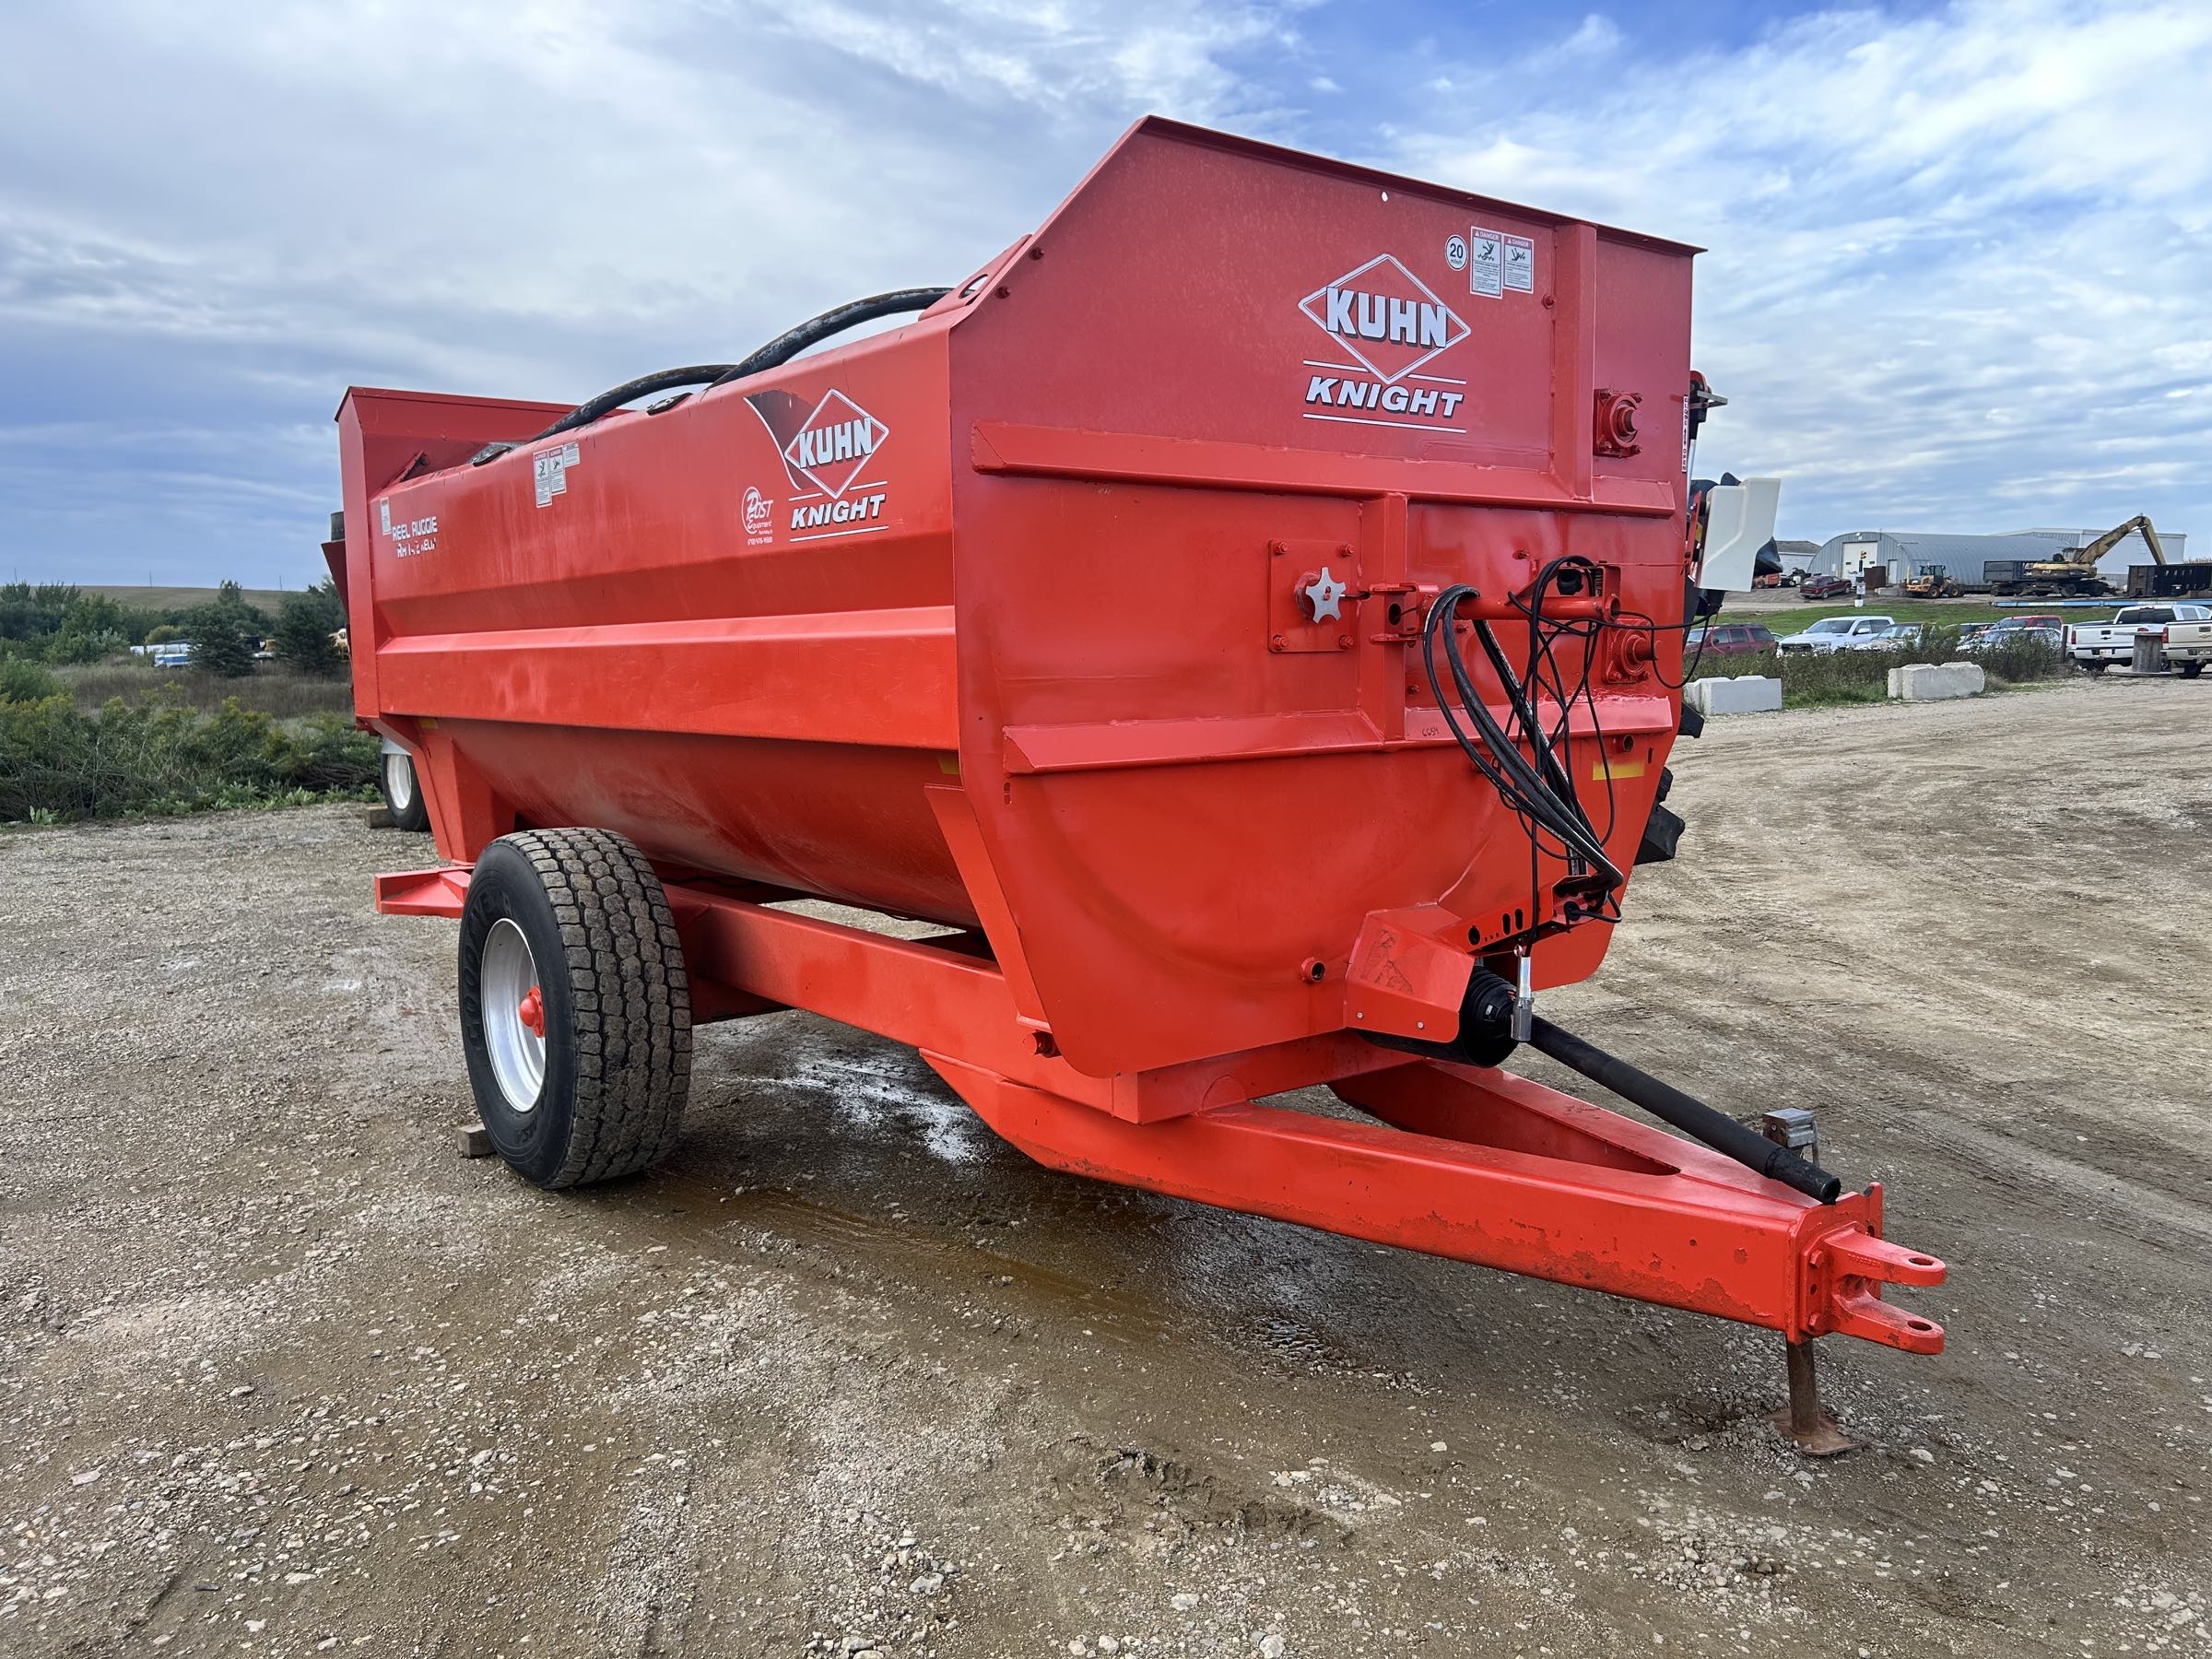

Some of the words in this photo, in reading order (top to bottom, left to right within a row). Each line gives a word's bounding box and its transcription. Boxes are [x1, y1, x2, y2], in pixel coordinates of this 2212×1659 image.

[1450, 243, 1464, 259] 20
[1479, 230, 1500, 241] DANGER
[1512, 237, 1529, 247] DANGER
[1325, 287, 1446, 349] KUHN
[1305, 375, 1465, 418] KNIGHT
[798, 417, 873, 469] KUHN
[790, 493, 887, 530] KNIGHT
[392, 523, 411, 542] REEL
[411, 516, 438, 537] AUGGIE
